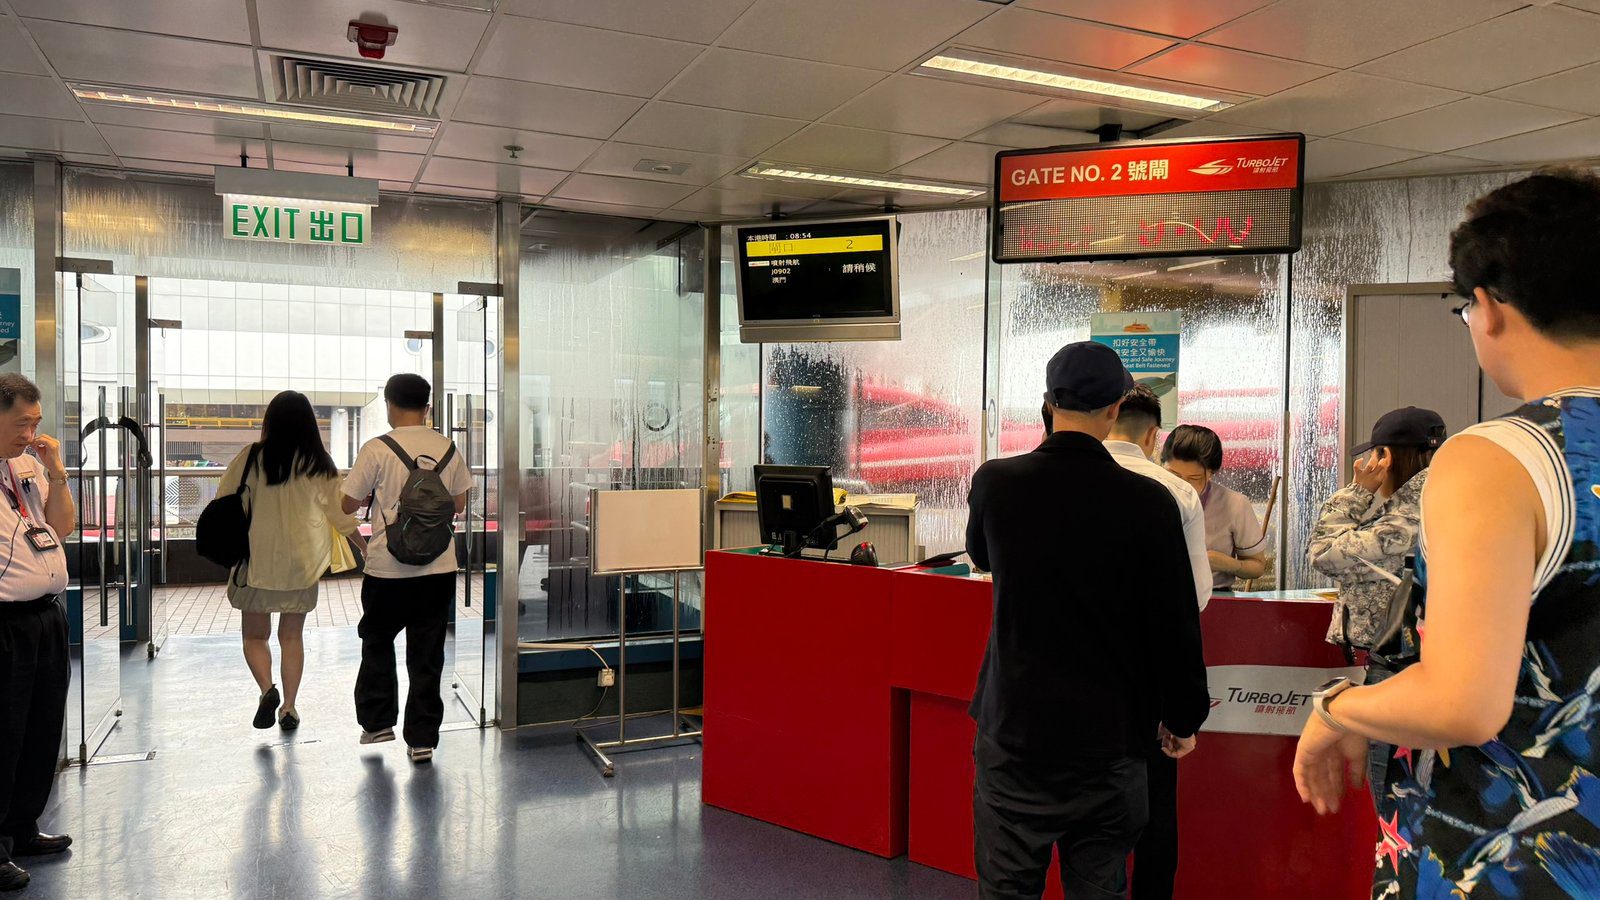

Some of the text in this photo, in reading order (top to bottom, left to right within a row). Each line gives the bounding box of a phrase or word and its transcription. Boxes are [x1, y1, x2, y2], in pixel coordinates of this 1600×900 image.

[1011, 159, 1169, 186] GATE NO. 2 號閘
[232, 204, 363, 243] EXIT 出口
[845, 239, 854, 250] 2
[842, 262, 877, 274] 請稍候
